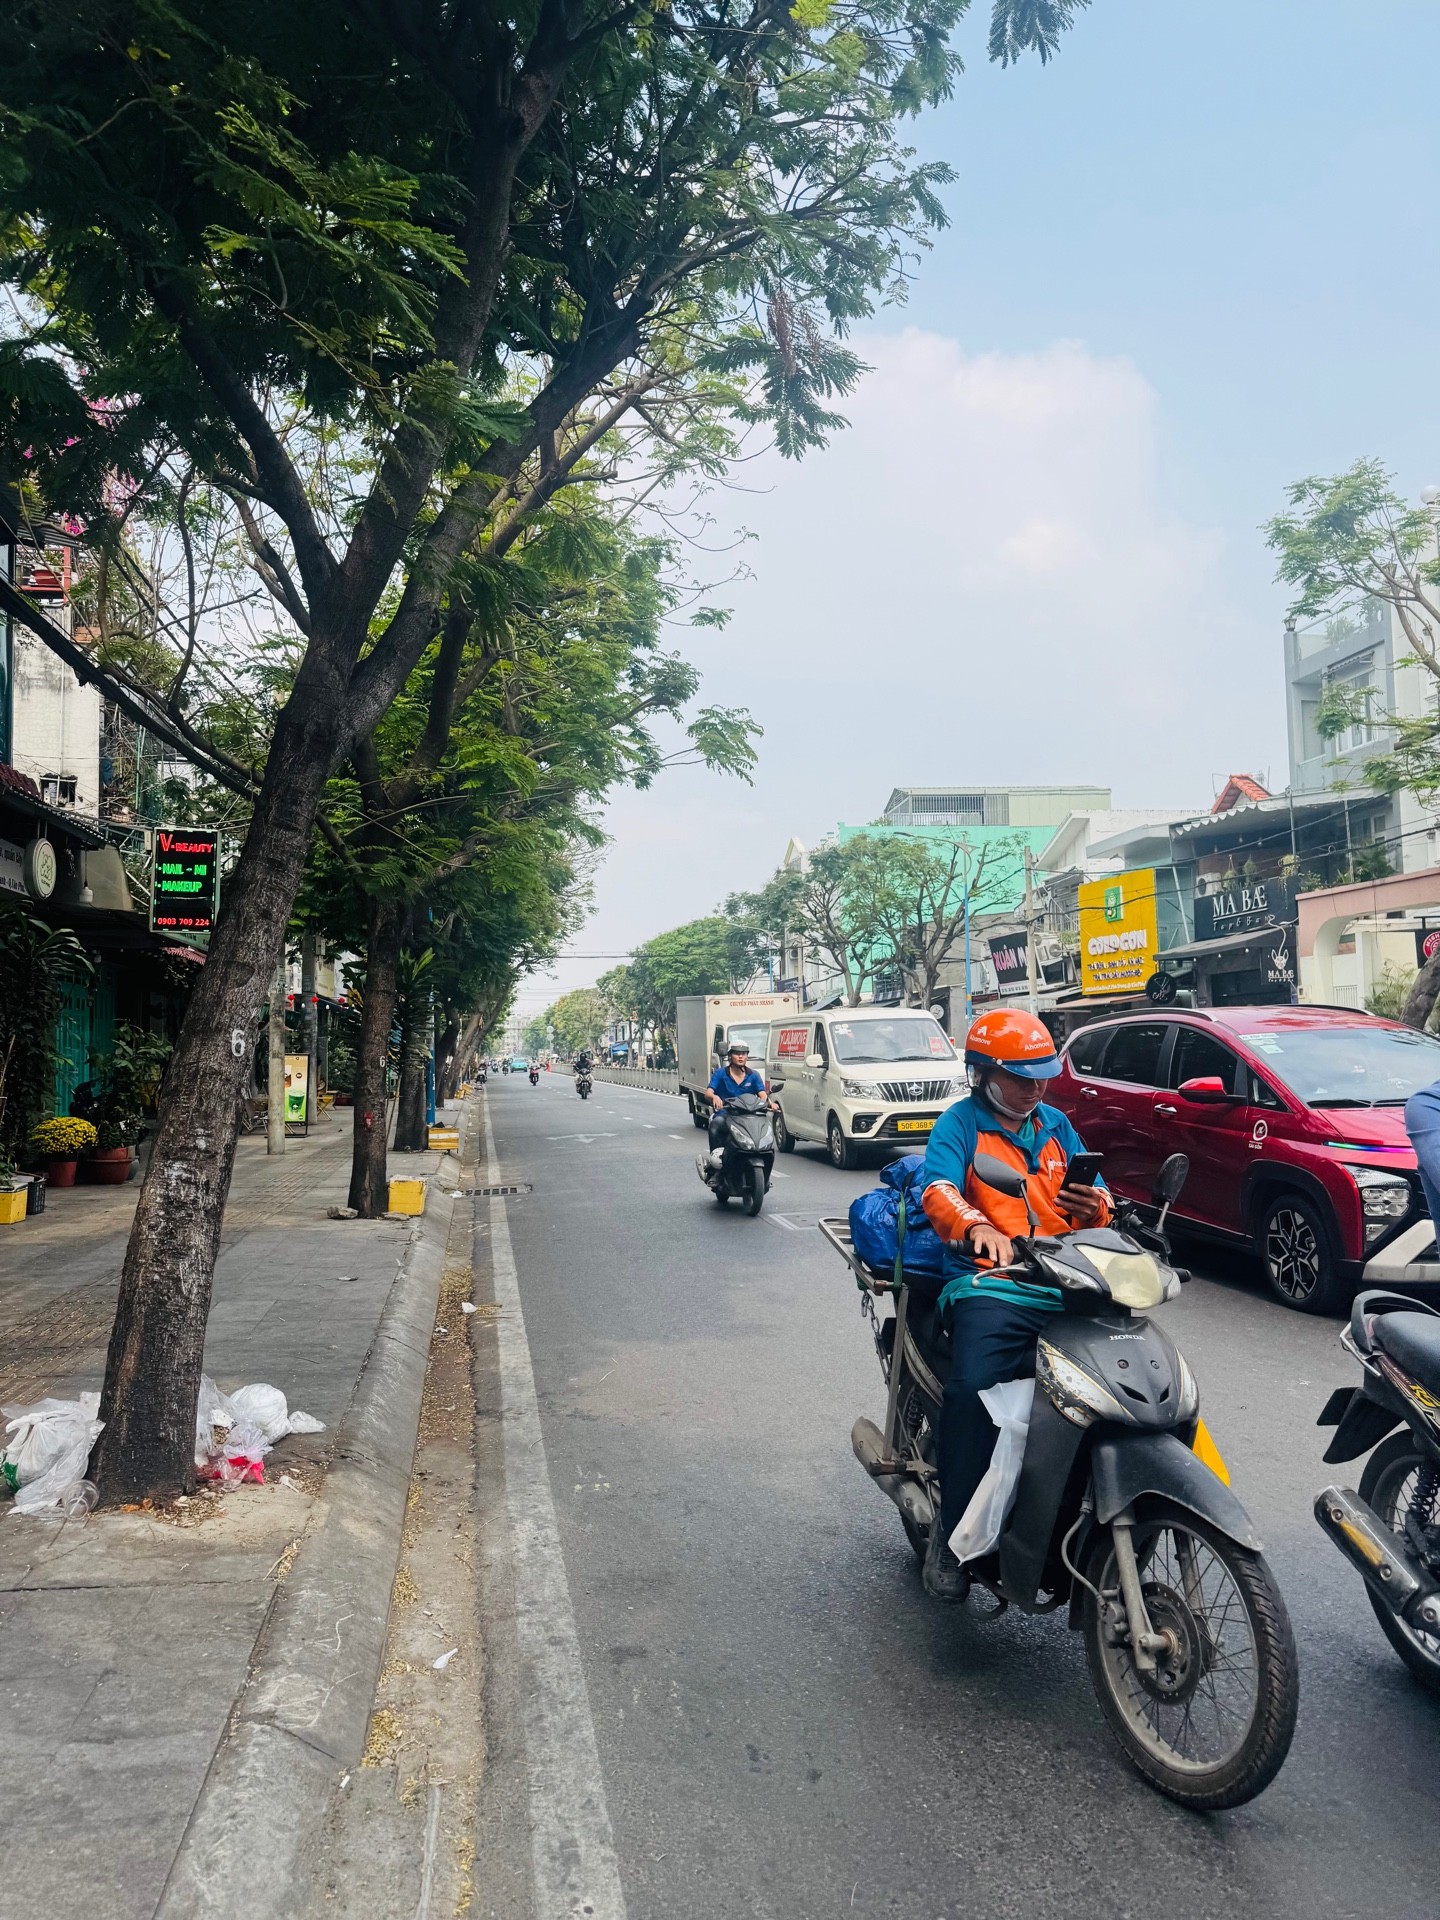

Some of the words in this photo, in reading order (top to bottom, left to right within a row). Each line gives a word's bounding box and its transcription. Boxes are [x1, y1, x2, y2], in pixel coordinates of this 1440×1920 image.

[160, 833, 213, 853] V-BEAUTY
[162, 863, 184, 874] NAIL
[194, 864, 207, 875] MI
[161, 880, 202, 892] MAKEUP
[1213, 893, 1237, 917] MA
[157, 917, 177, 926] 0903
[179, 918, 193, 926] 709
[993, 944, 1018, 972] XUÂN
[231, 1029, 246, 1057] 6
[1024, 1041, 1050, 1052] Ahamove
[379, 1055, 386, 1068] 6
